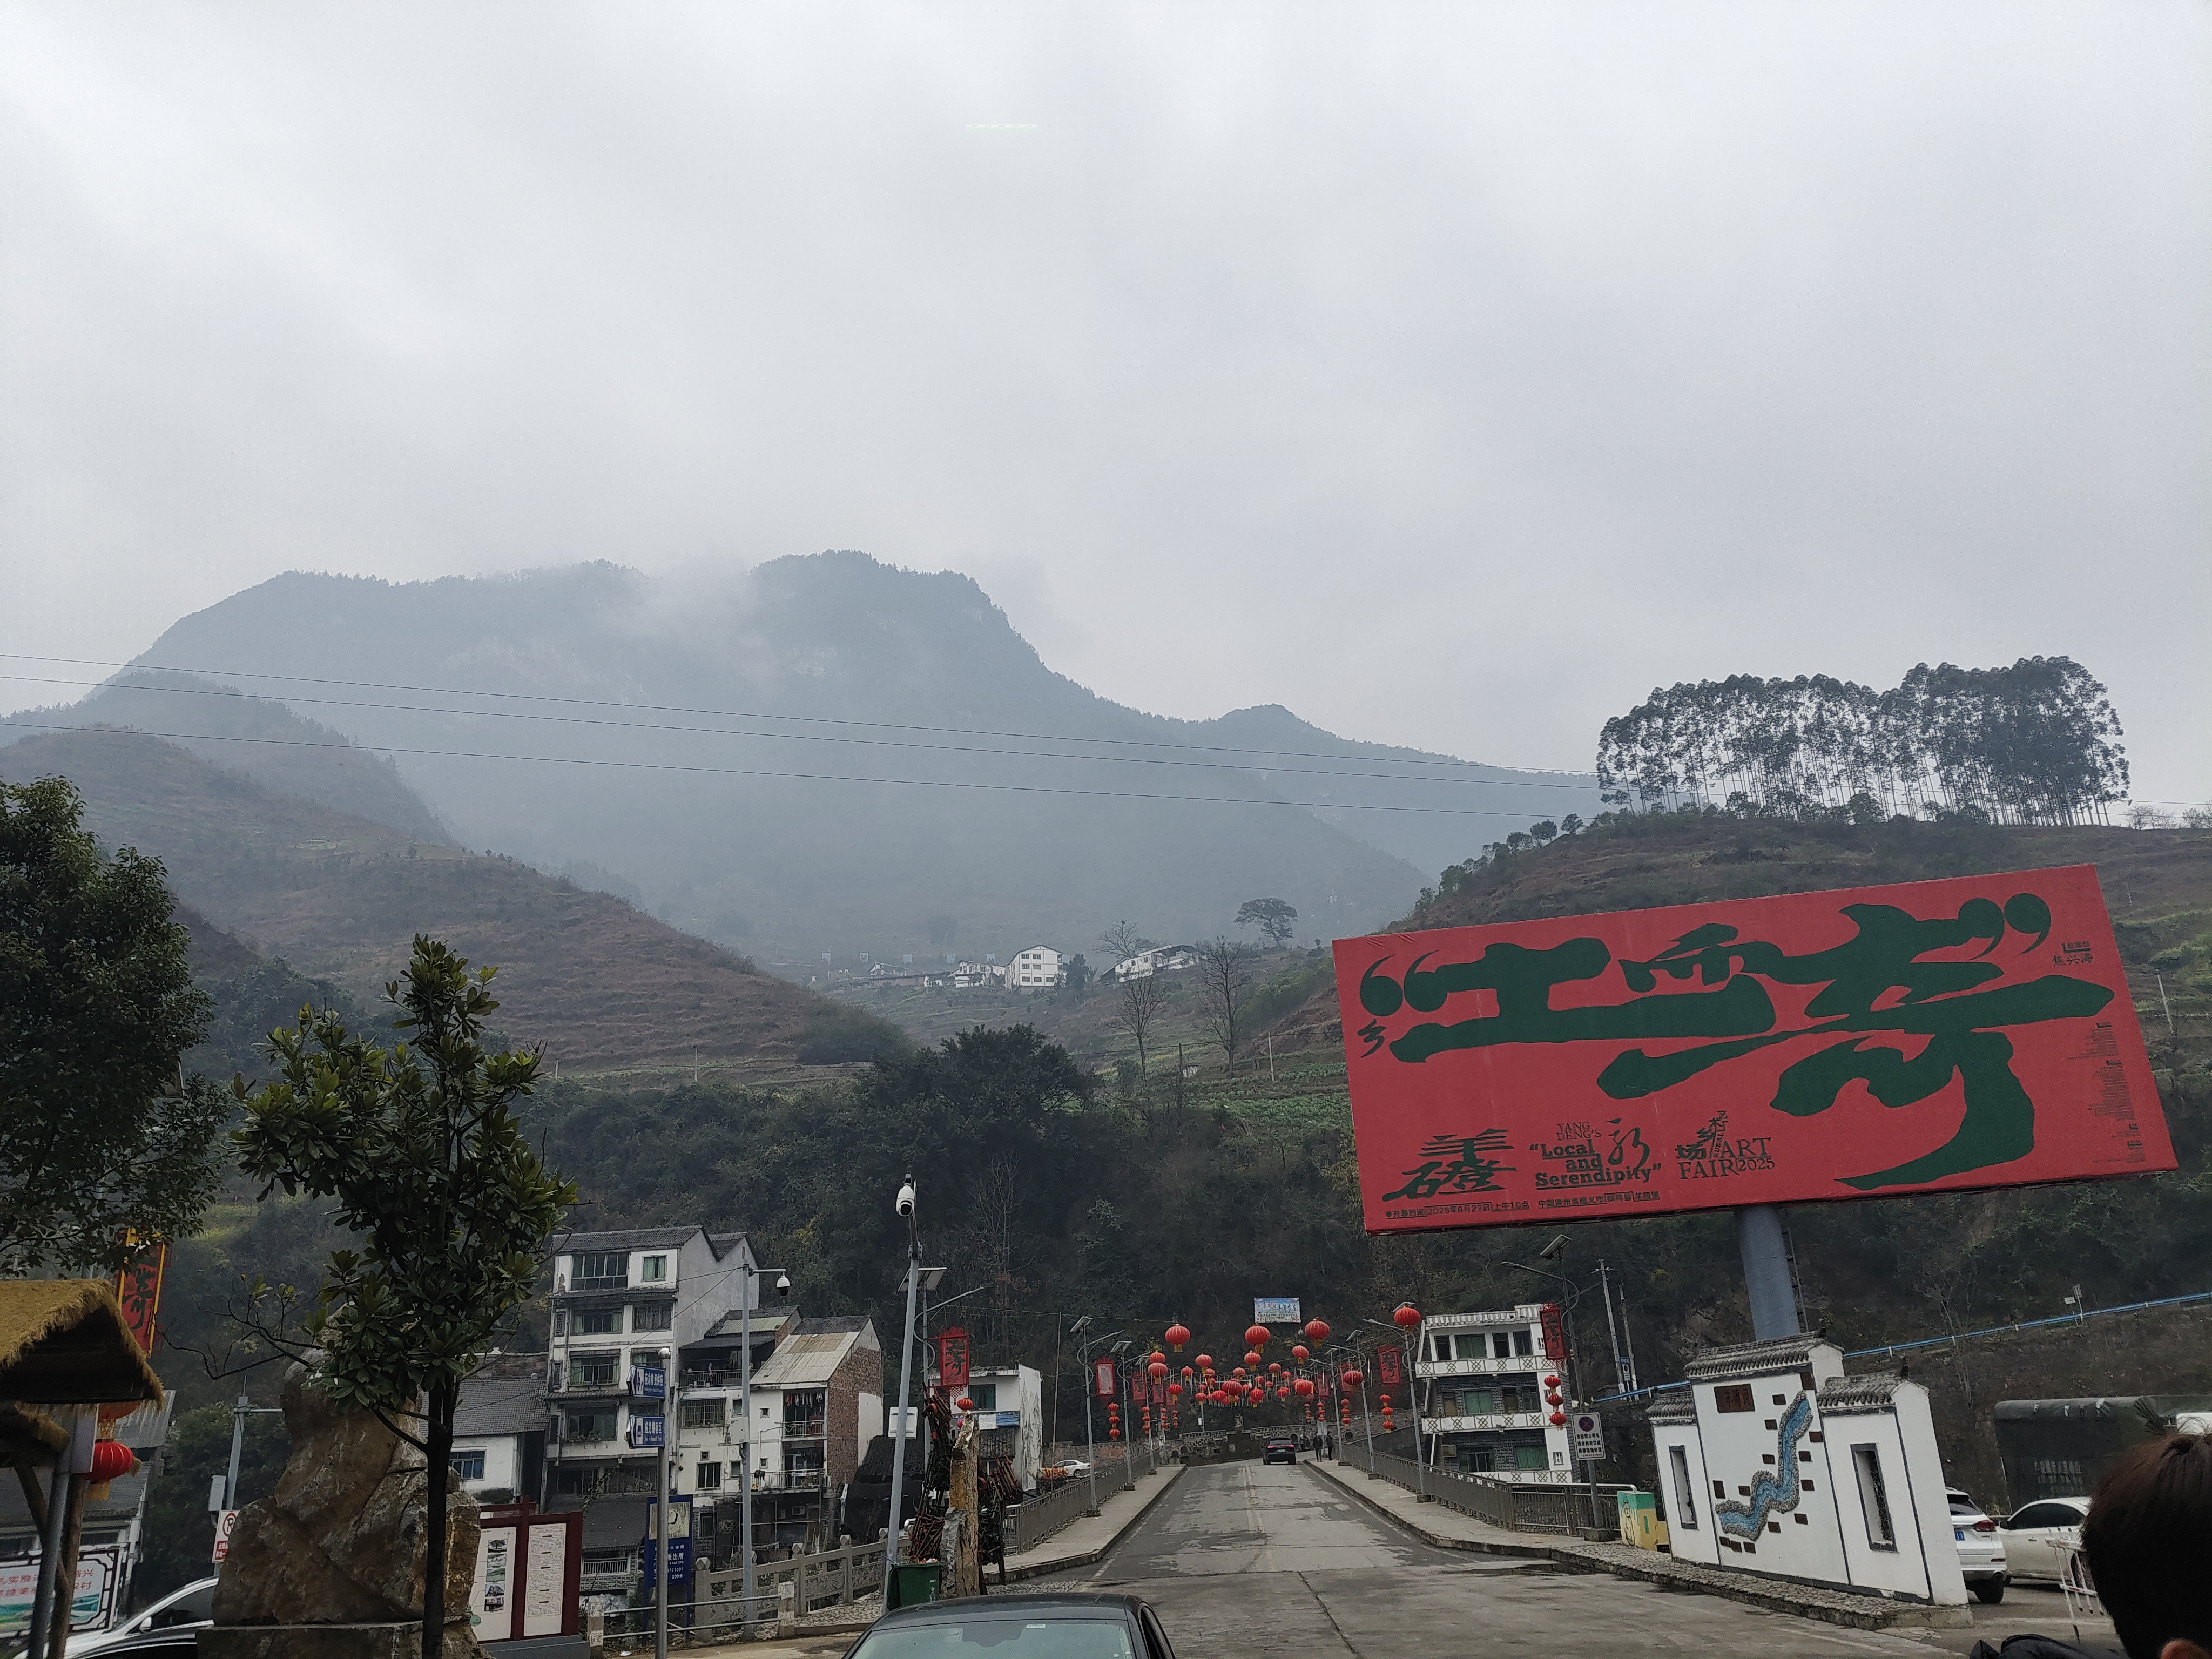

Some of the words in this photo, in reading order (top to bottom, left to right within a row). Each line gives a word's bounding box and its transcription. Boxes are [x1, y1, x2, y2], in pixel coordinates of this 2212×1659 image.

[1557, 1122, 1590, 1132] YANG
[1556, 1129, 1602, 1141] DENG'S
[1721, 1137, 1771, 1158] ART
[1566, 1153, 1603, 1169] and
[1737, 1158, 1775, 1171] 2025
[1678, 1159, 1740, 1179] FAIR
